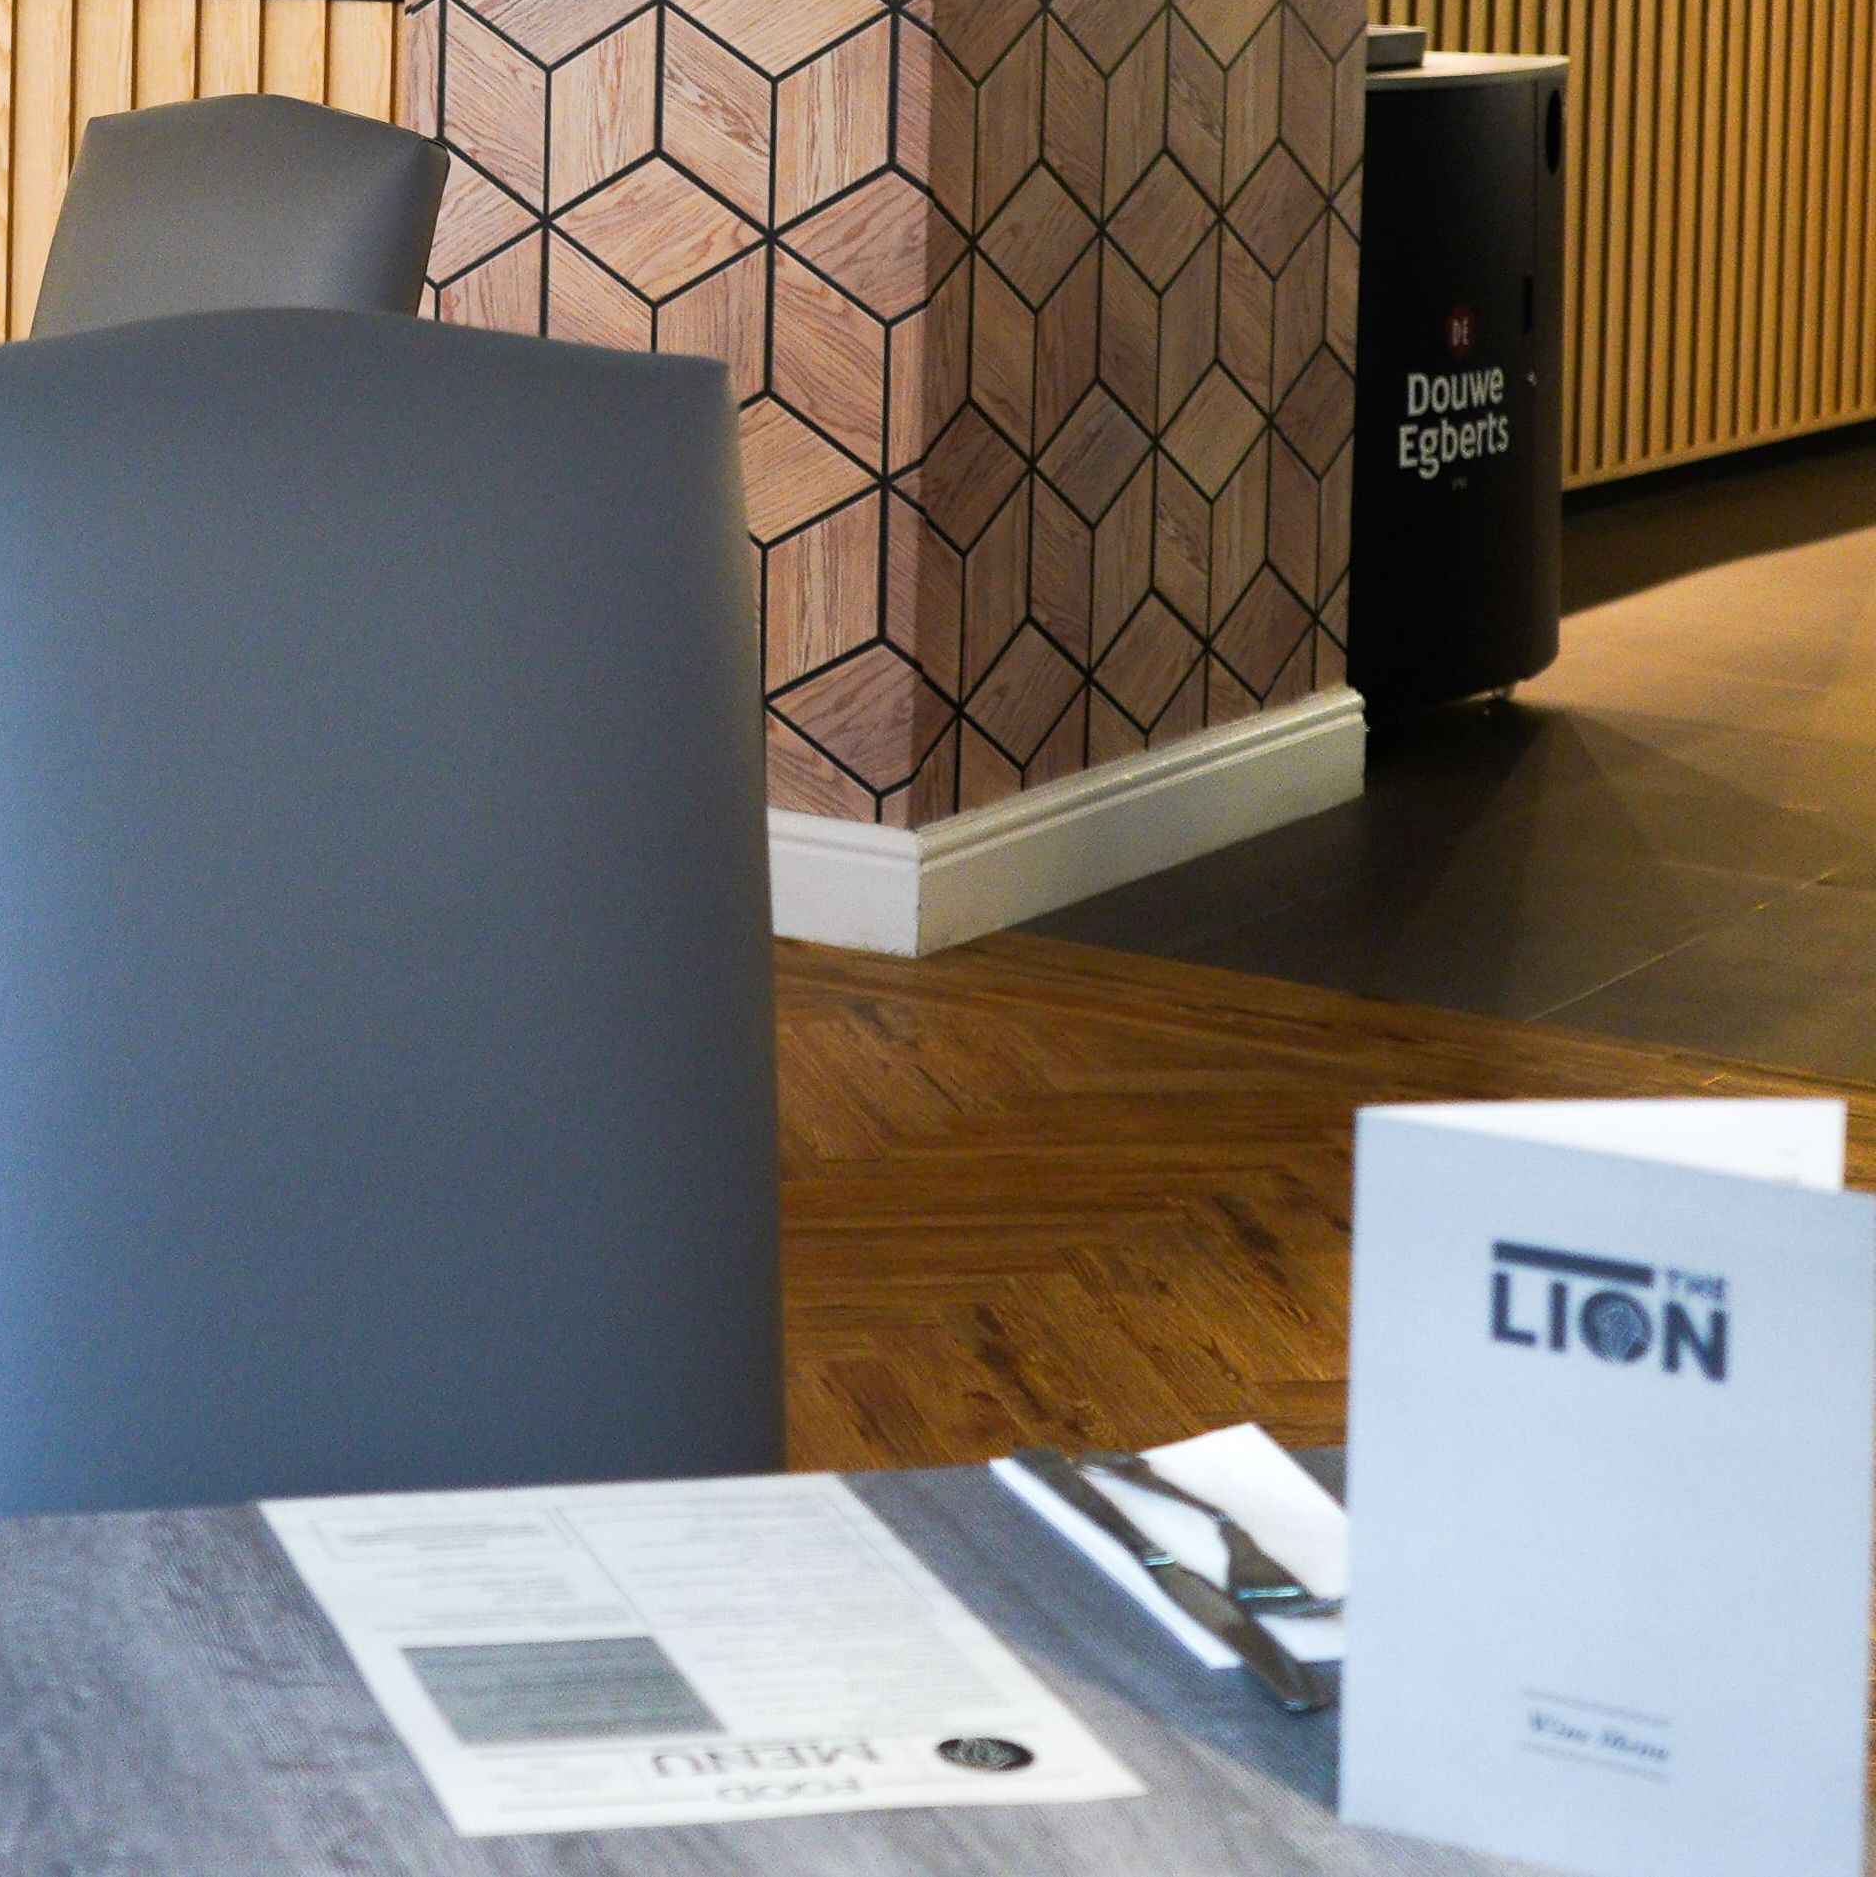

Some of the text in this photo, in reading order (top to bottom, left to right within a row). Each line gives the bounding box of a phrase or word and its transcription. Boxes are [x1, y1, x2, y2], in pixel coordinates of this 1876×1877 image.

[1407, 366, 1505, 417] Douwe
[1399, 412, 1509, 480] Egberts
[1490, 1271, 1729, 1382] LION
[650, 1736, 883, 1779] MENU
[716, 1774, 865, 1805] FOOD
